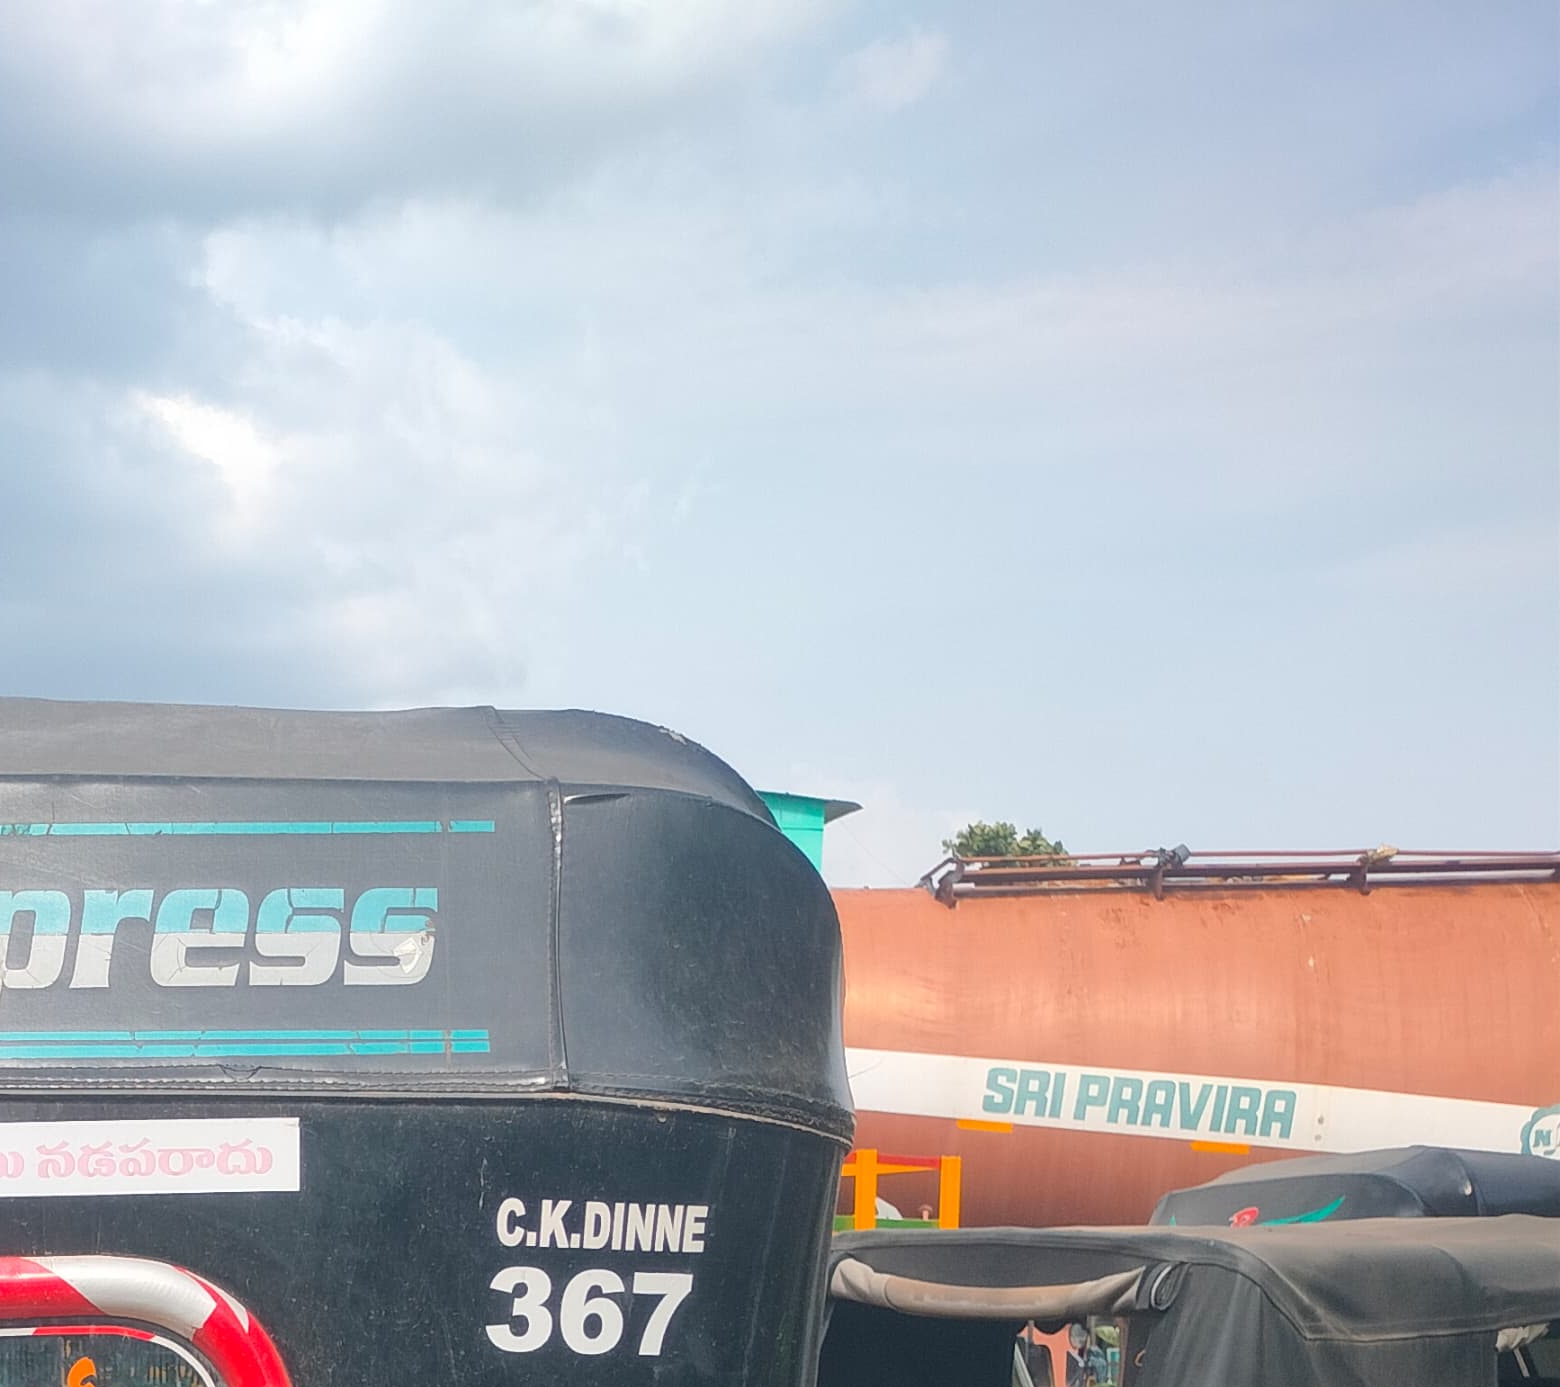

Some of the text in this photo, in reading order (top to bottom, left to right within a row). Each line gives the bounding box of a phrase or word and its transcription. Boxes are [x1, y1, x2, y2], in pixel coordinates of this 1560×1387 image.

[982, 1067, 1297, 1140] SRI PRAVIRA
[35, 1135, 274, 1178] నడపరాదు
[496, 1196, 709, 1253] C.K.DINNE
[485, 1266, 694, 1357] 367
